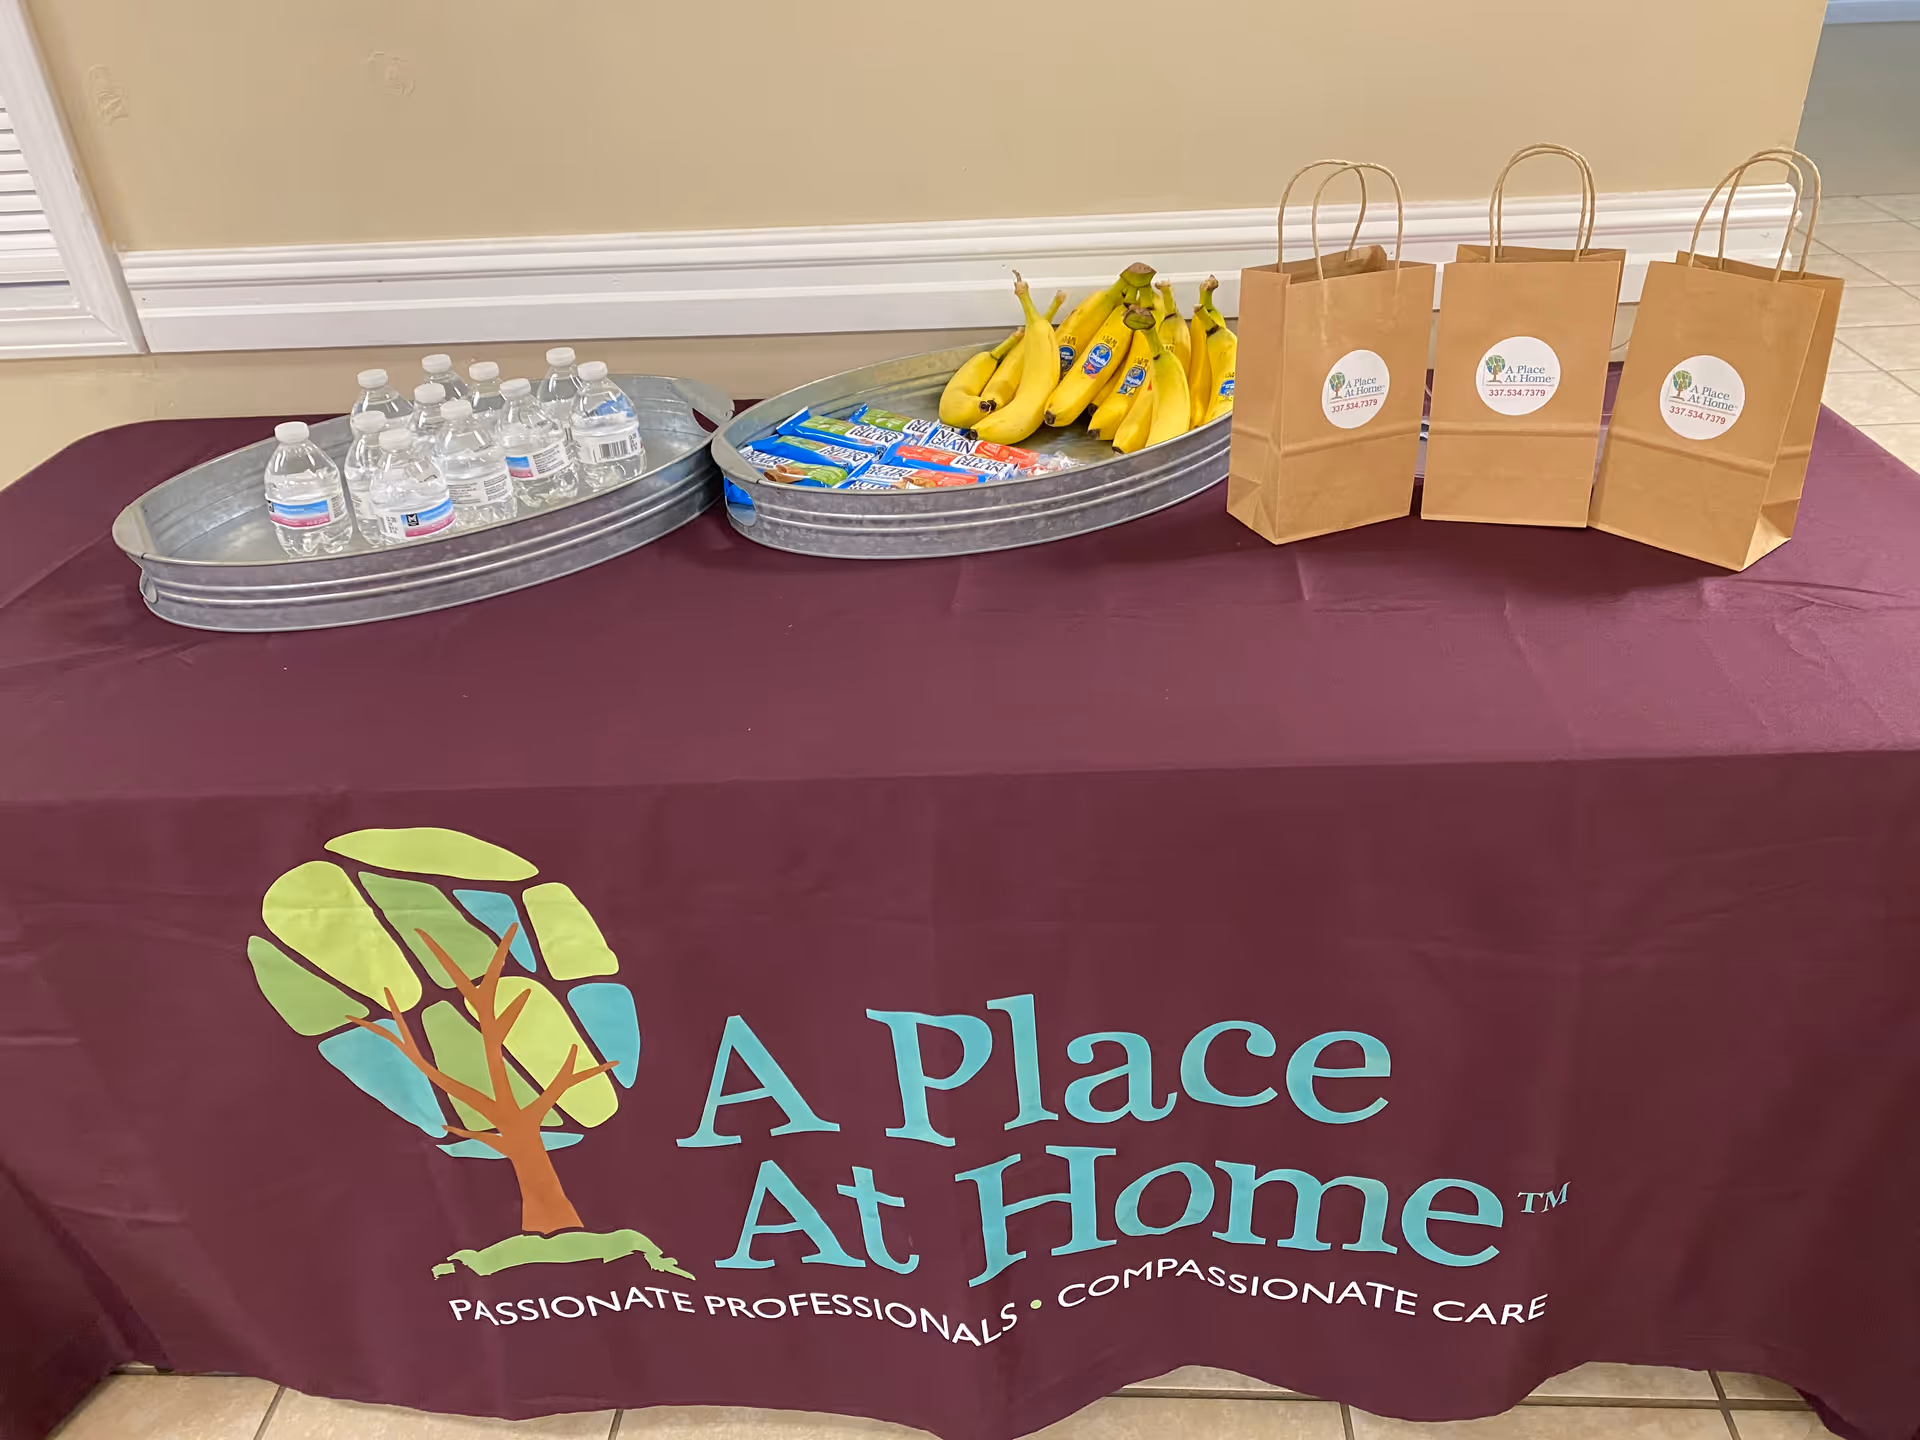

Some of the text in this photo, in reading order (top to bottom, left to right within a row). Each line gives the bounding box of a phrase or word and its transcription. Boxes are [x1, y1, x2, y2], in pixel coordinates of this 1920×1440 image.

[1505, 365, 1546, 374] A Place
[1345, 377, 1377, 389] A Place
[1504, 374, 1552, 383] At Home
[1344, 386, 1382, 398] At Home
[1488, 389, 1546, 397] 337.534.7379
[1690, 385, 1730, 400] A Place
[1331, 399, 1378, 413] 337.534.7379
[1687, 394, 1734, 411] At Home
[1670, 406, 1726, 424] 337.534.7379
[931, 438, 976, 455] GRAIN
[677, 994, 1392, 1148] A Place
[715, 1160, 920, 1275] At
[955, 1146, 1504, 1287] Home
[448, 1258, 1548, 1347] PASSIONATE PROFESSIONALS COMPASSIONATE CARE
